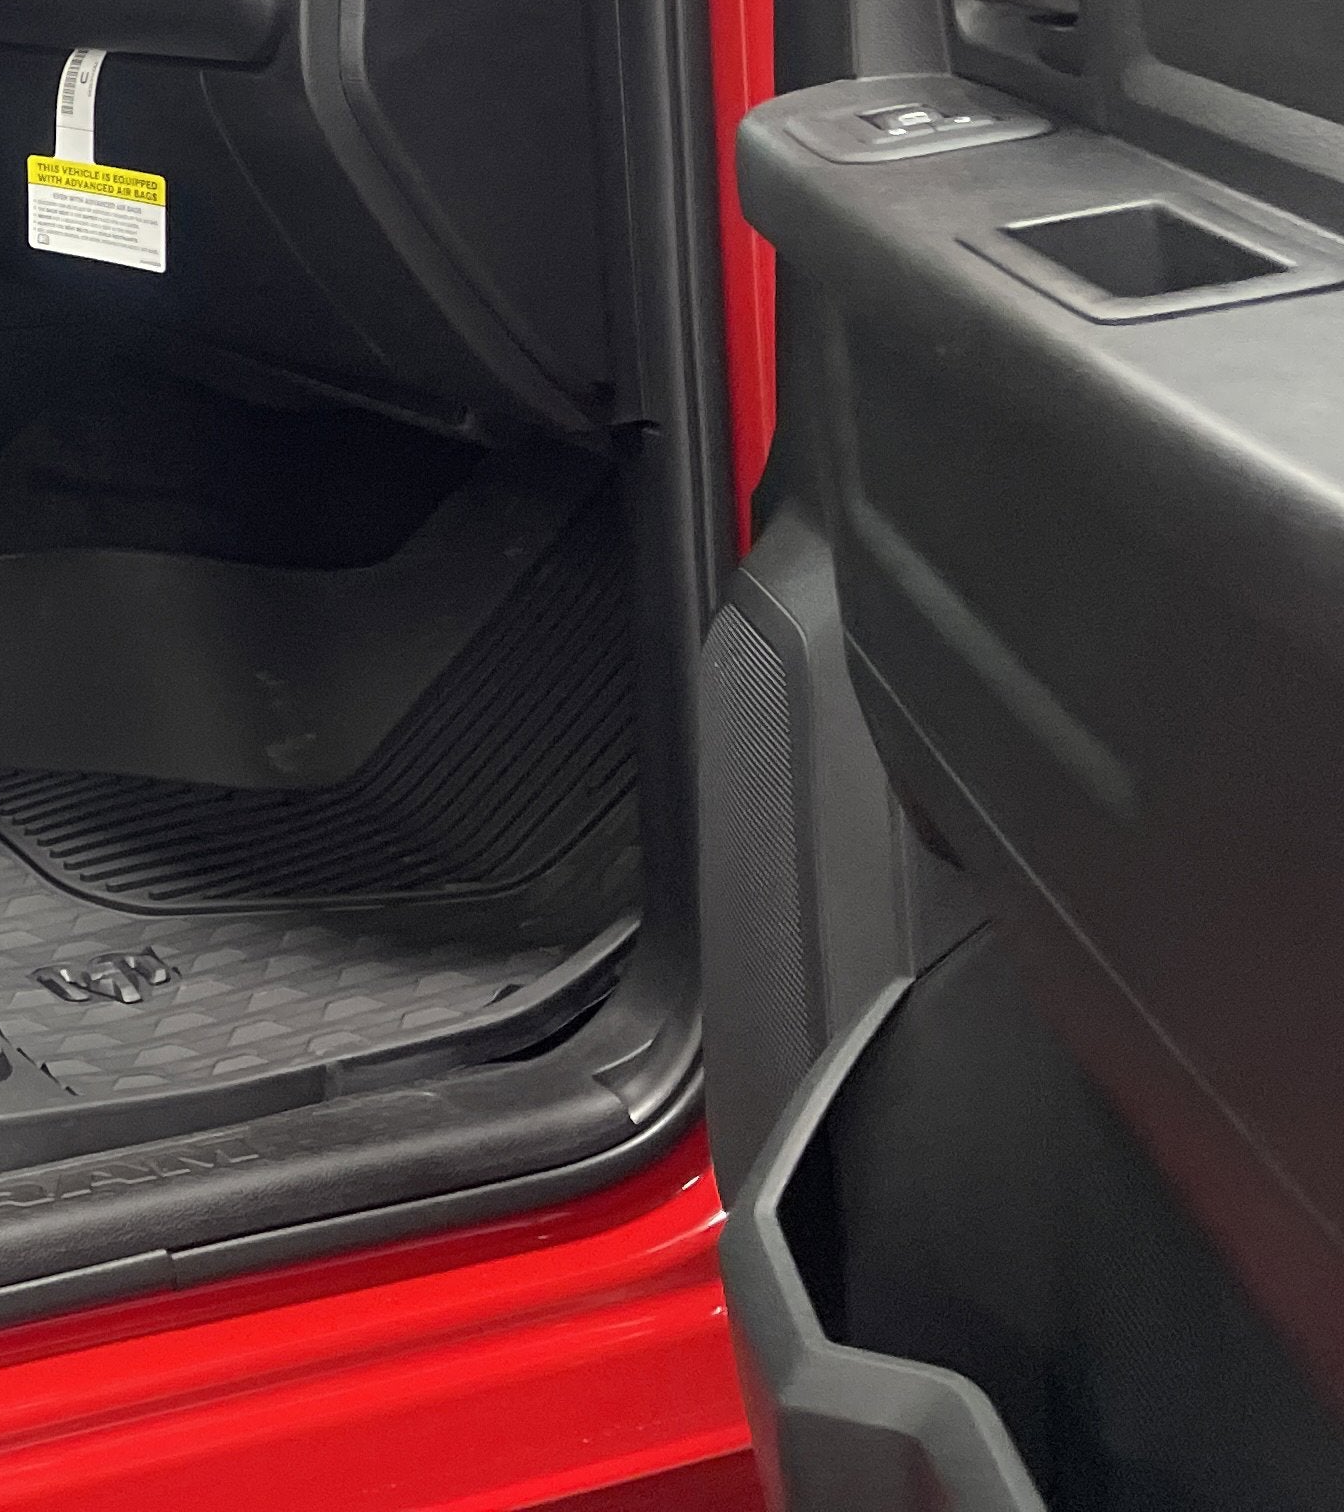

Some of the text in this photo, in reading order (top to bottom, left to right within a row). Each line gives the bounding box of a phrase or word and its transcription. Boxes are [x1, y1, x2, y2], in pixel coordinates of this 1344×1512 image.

[37, 162, 158, 190] THIS VEHICLE IS EQUIPPED
[37, 173, 158, 202] WITH ADVANCED AIR BAGS
